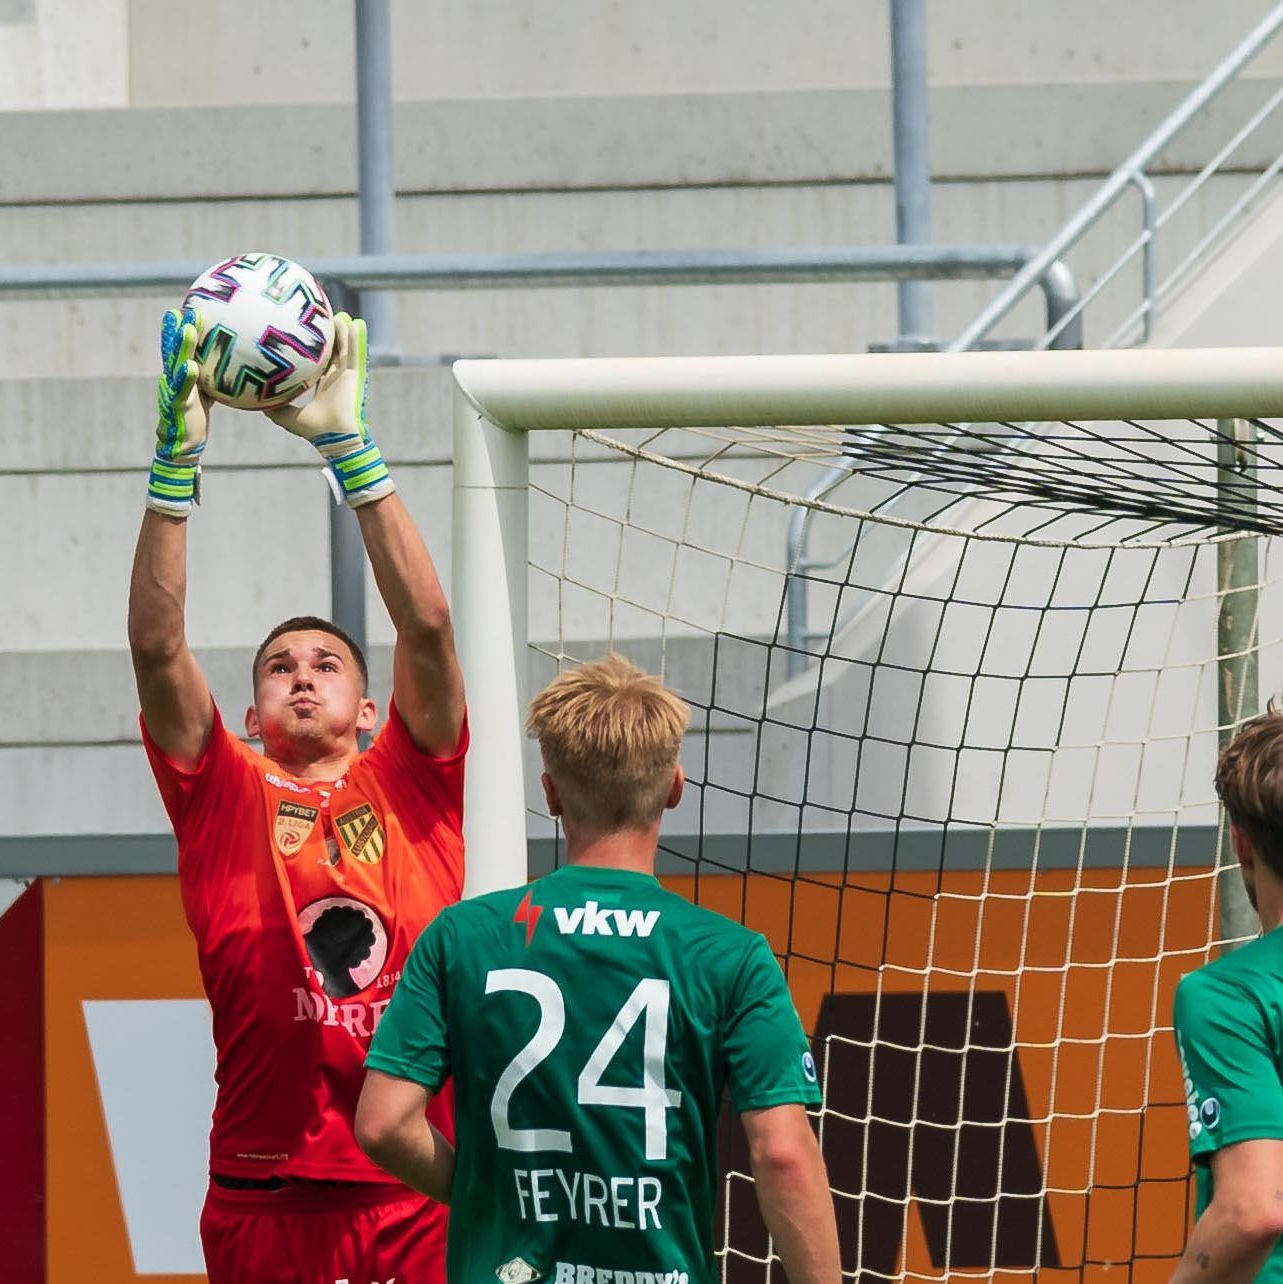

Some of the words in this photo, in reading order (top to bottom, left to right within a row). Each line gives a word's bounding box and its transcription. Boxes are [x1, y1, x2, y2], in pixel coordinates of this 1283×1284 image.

[280, 804, 317, 818] HPYBET
[553, 901, 661, 937] vkw
[484, 968, 682, 1161] 24
[514, 1168, 662, 1231] FEYRER
